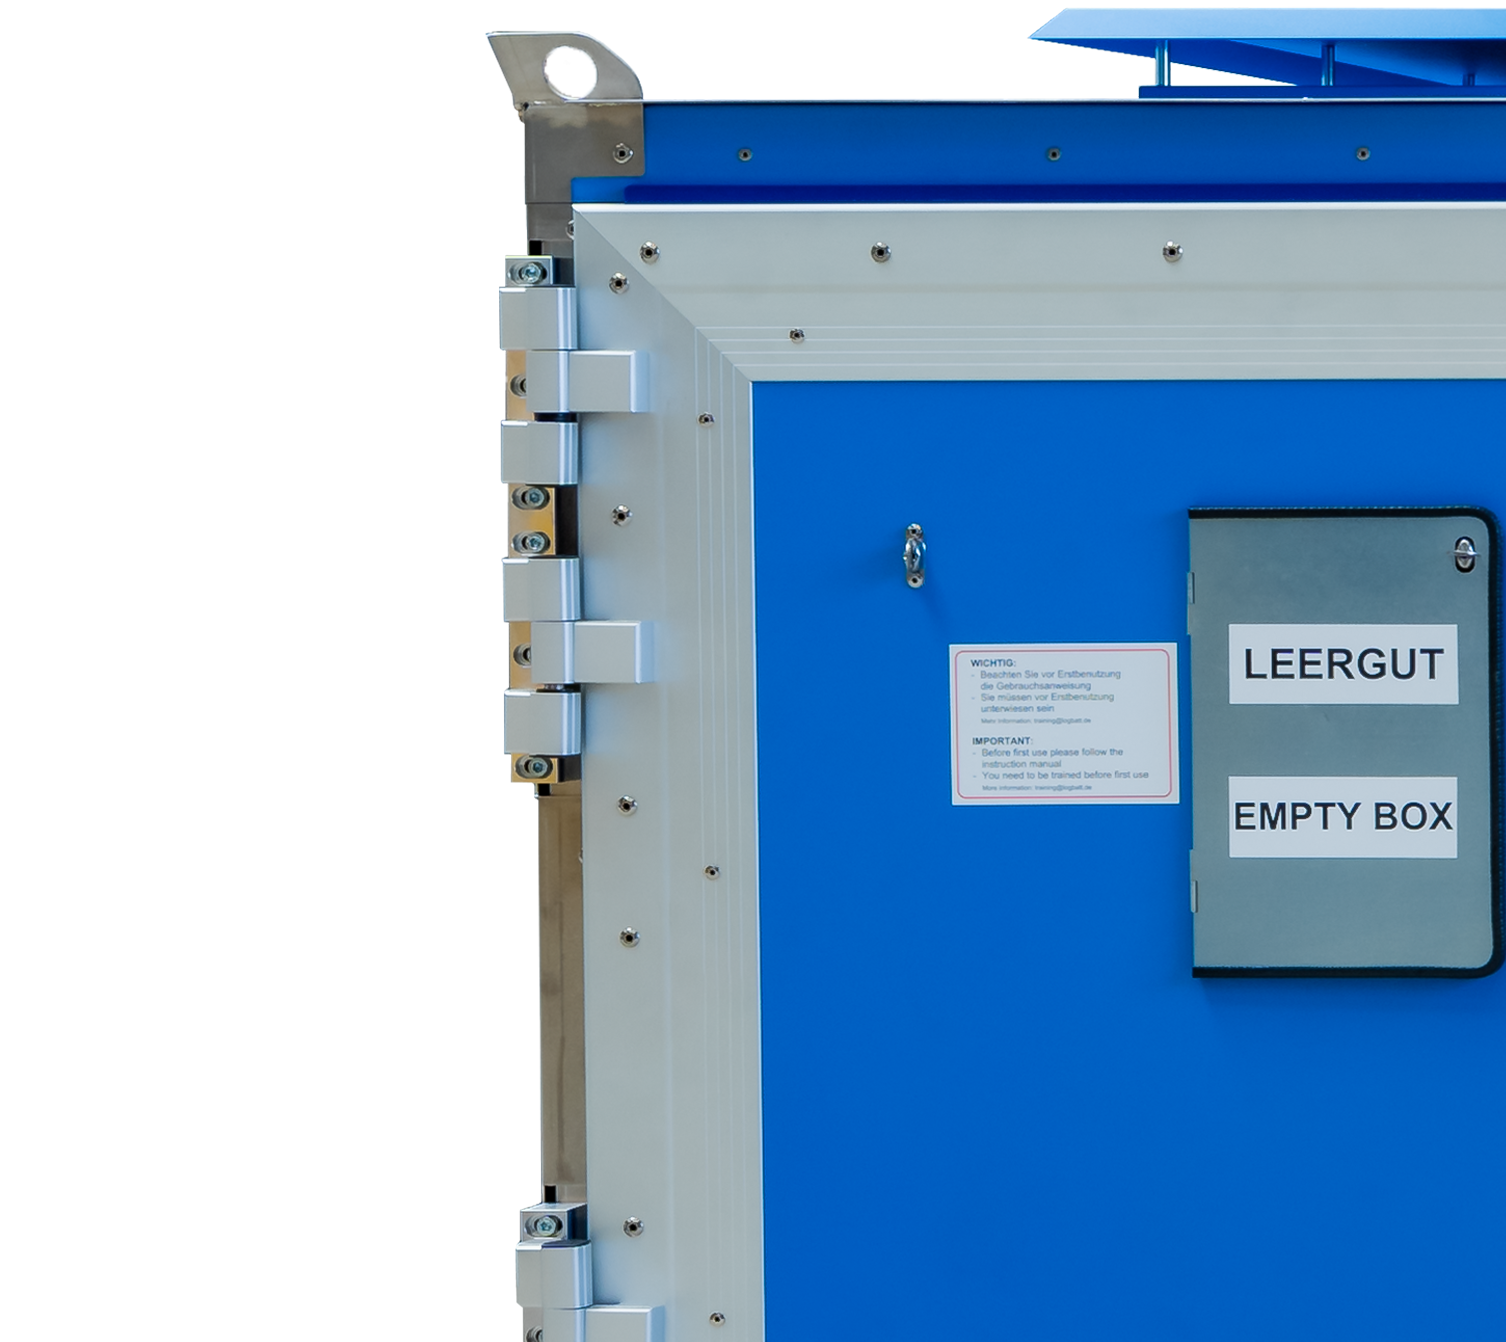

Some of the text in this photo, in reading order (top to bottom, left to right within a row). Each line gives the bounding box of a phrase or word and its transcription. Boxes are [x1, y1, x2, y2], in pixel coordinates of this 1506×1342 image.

[970, 659, 1016, 668] WICHTIG:
[1245, 648, 1444, 680] LEERGUT
[981, 670, 1022, 680] Beachten
[1024, 670, 1038, 680] Sie
[1058, 670, 1121, 680] Erstbenutzung
[981, 682, 1091, 692] die Gebrauchsanweisung
[981, 693, 995, 702] Sie
[997, 693, 1032, 702] müssen
[1051, 693, 1114, 702] Erstbenutzung
[981, 704, 1054, 713] unterwiesen sein
[972, 737, 1033, 746] IMPORTANT:
[982, 748, 1011, 757] Before
[1013, 748, 1030, 757] first
[1050, 748, 1079, 758] please
[1082, 748, 1107, 757] follow
[1109, 748, 1123, 757] the
[982, 760, 1062, 768] instruction manual
[982, 770, 1149, 780] You need to be trained before first use
[1235, 802, 1453, 831] EMPTY BOX
